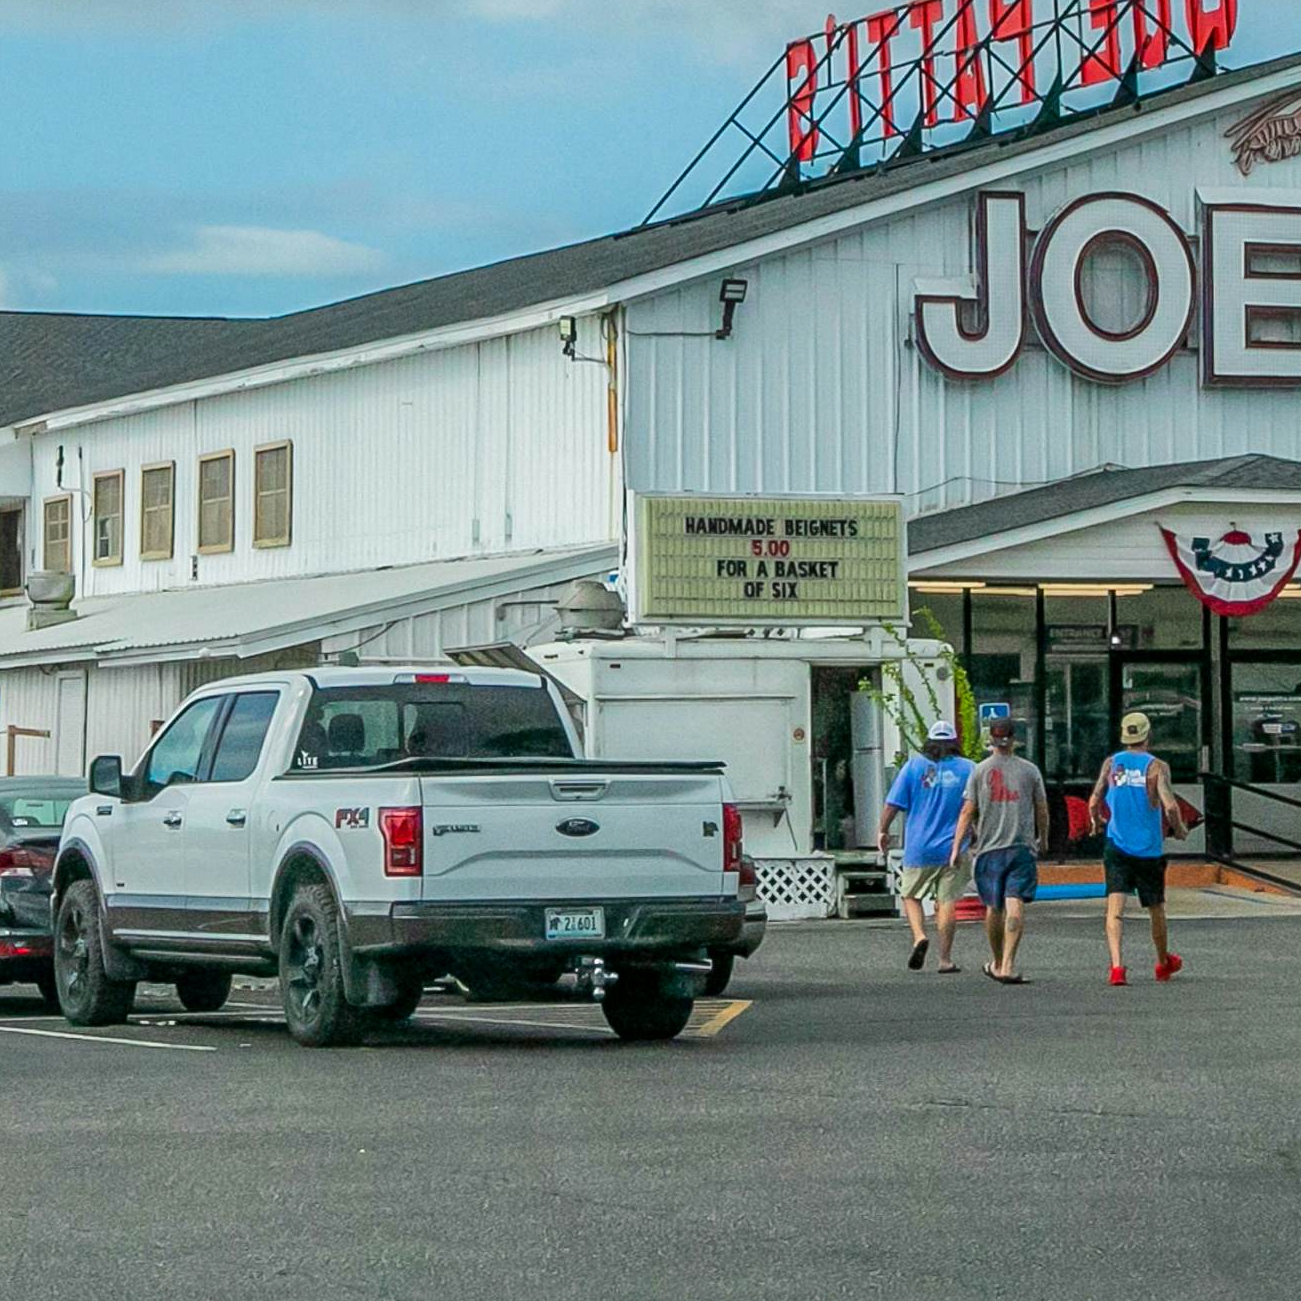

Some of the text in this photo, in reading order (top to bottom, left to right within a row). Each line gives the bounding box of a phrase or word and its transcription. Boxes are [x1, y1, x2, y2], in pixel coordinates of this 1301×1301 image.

[685, 517, 858, 536] HANDMADE BEIGNETS
[751, 539, 790, 557] 5.00
[717, 560, 838, 578] FOR A BASKET
[744, 582, 798, 598] OF SIX
[336, 807, 369, 828] FX4
